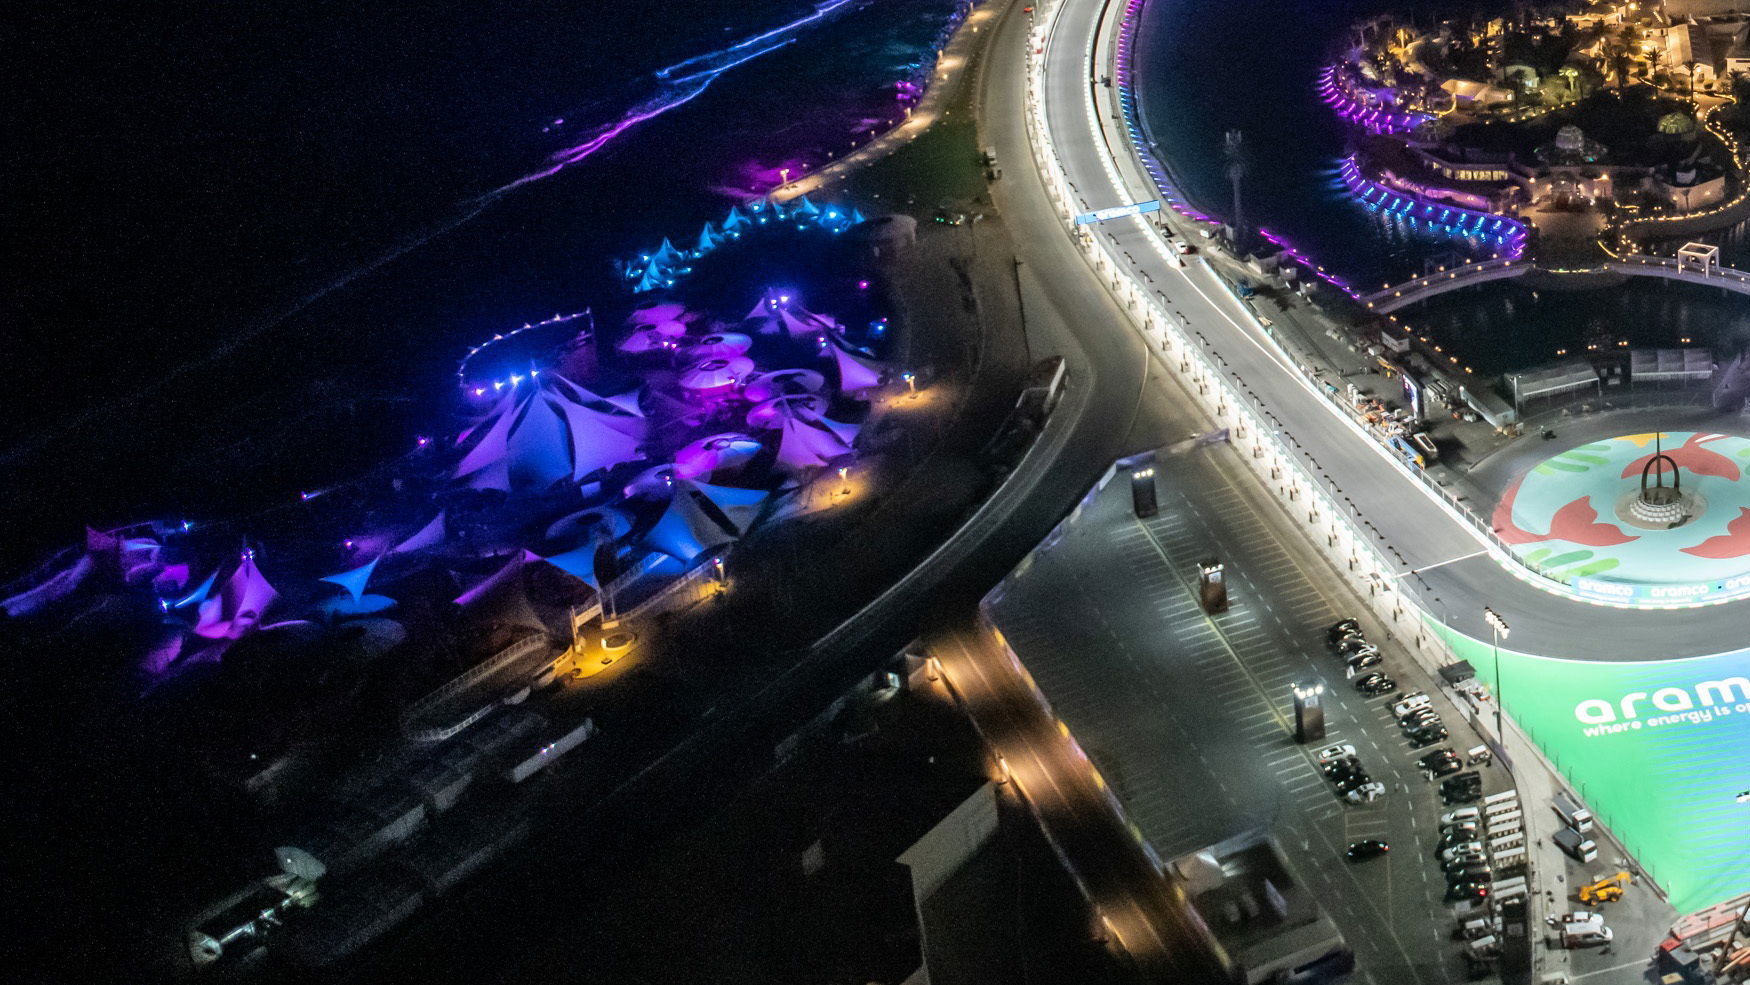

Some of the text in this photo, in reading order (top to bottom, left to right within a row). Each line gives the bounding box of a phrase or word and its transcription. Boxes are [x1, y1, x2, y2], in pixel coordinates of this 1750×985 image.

[1578, 579, 1633, 597] aramco
[1650, 584, 1709, 597] aramco
[1583, 720, 1642, 737] where
[1647, 709, 1712, 726] energy
[1714, 706, 1731, 716] is
